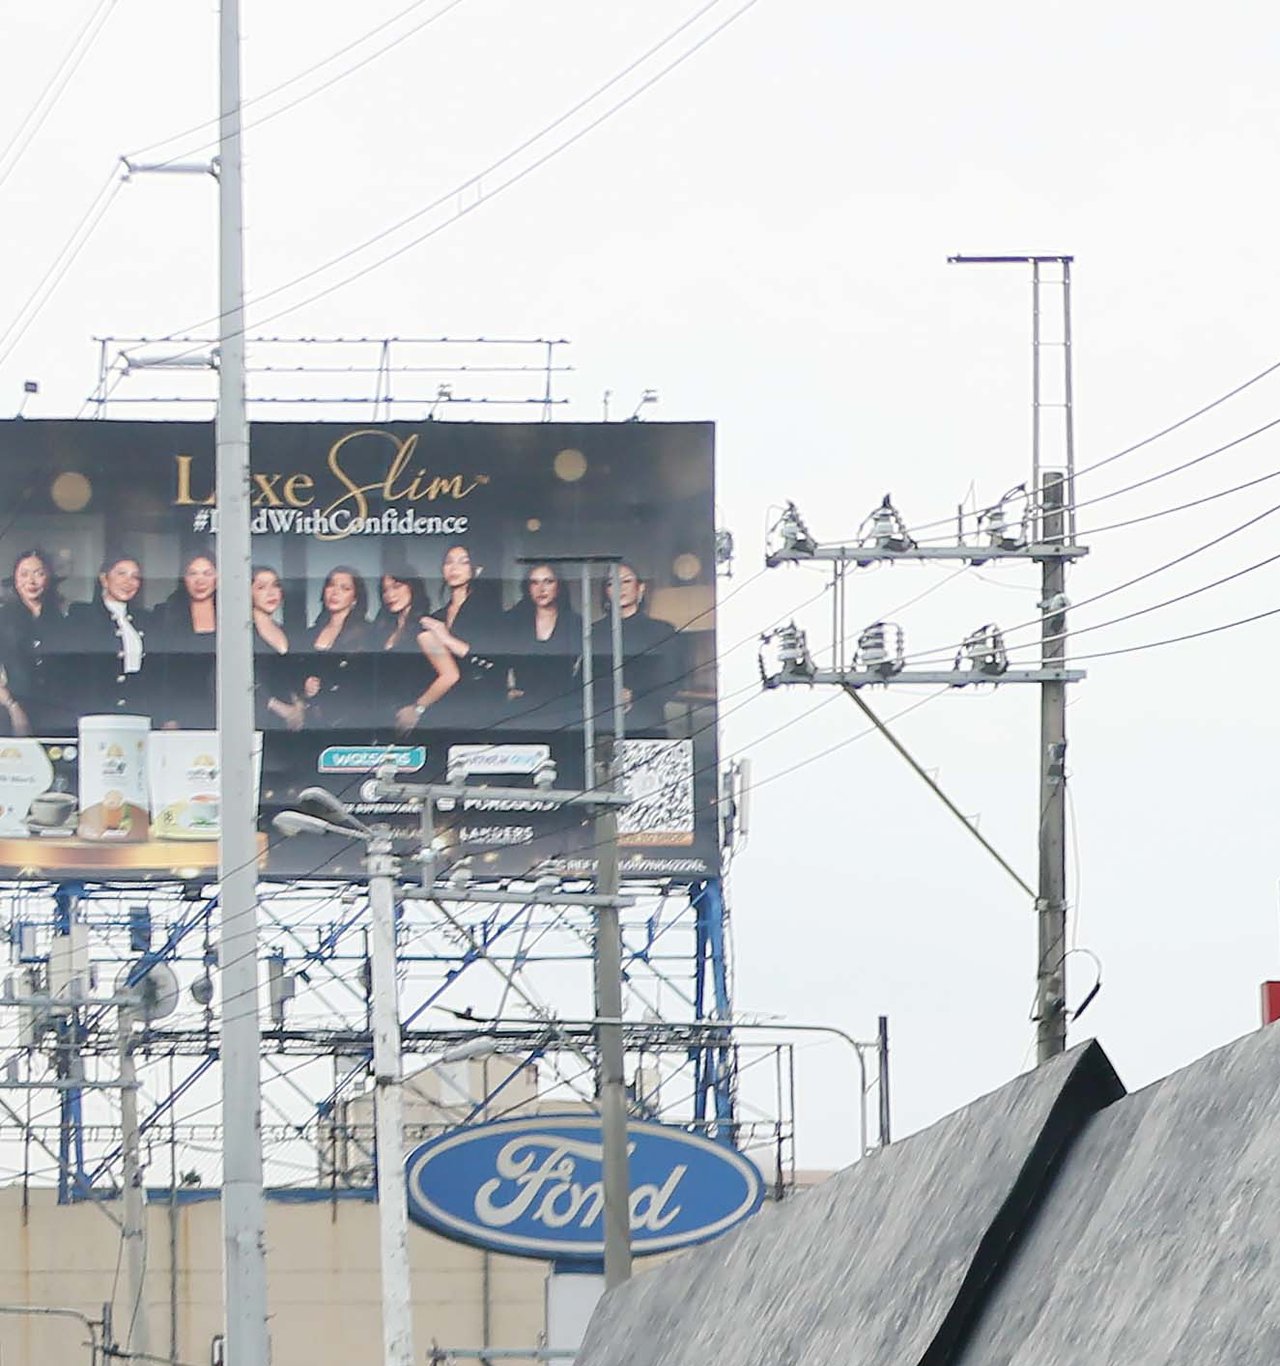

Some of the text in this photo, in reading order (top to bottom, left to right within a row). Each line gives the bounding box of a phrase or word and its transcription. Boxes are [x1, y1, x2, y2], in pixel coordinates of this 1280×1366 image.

[174, 429, 485, 540] Lxe Slim
[192, 508, 469, 536] #LdWithConfidence
[475, 1135, 688, 1231] Ford
